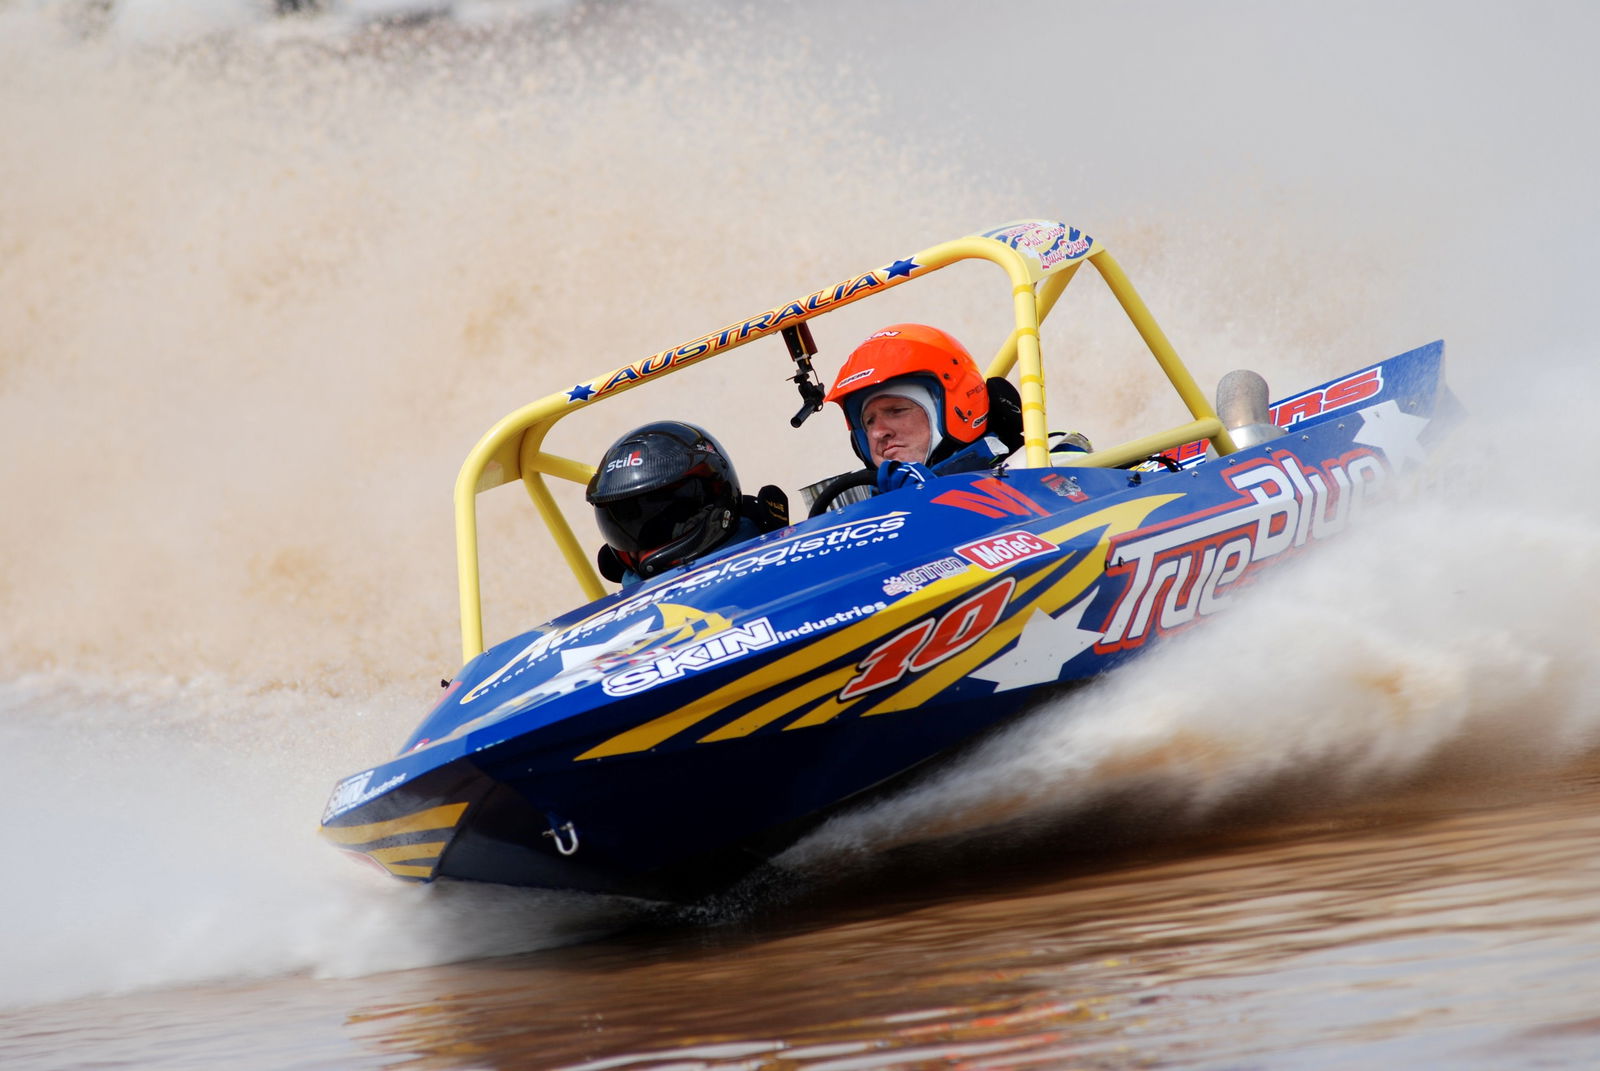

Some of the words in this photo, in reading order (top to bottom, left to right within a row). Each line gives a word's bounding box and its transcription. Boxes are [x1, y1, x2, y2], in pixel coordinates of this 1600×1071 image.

[599, 271, 882, 392] AUSTRALIA
[970, 534, 1044, 567] MoTeC
[1101, 500, 1254, 645] True
[480, 646, 561, 696] STORAGE
[569, 623, 607, 646] AND
[775, 532, 900, 567] SOLUTIONS
[602, 617, 779, 697] SKIN
[839, 577, 1016, 701] 10
